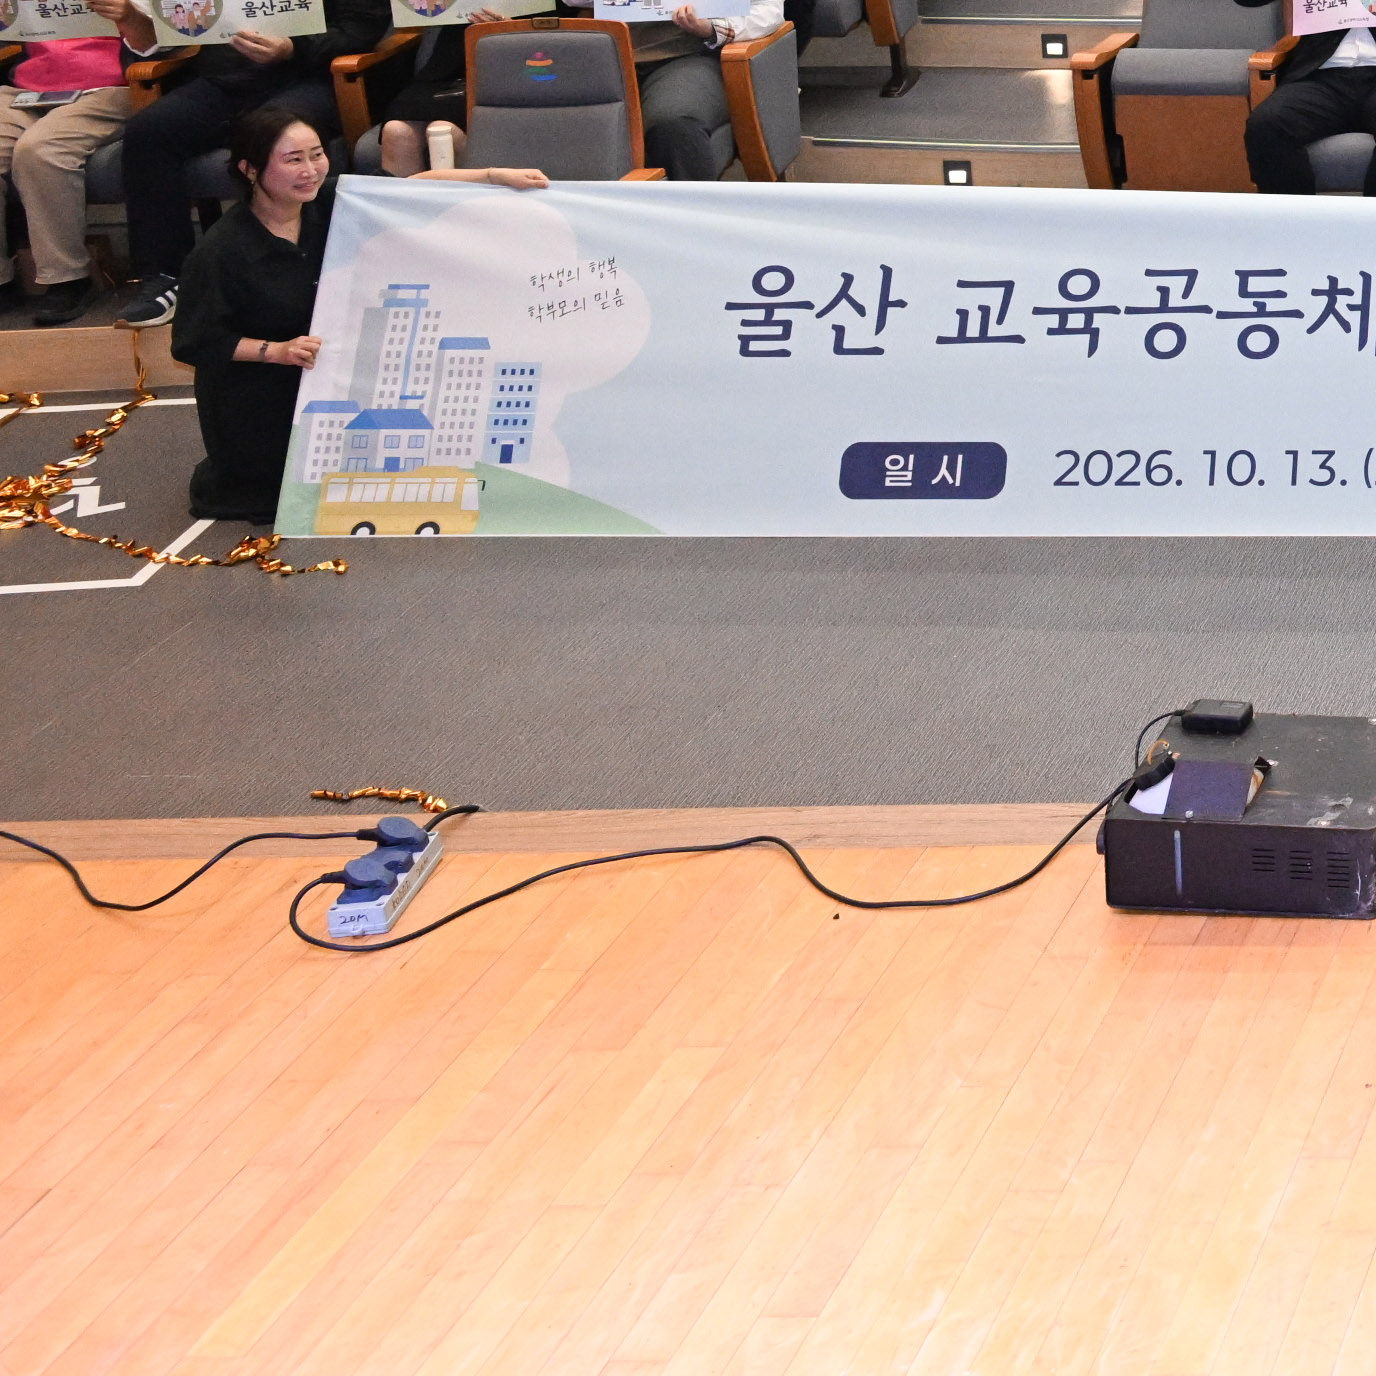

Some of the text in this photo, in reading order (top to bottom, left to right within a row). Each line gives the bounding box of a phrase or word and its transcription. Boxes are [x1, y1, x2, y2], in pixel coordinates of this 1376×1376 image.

[530, 256, 618, 292] 학생의 행복
[528, 288, 626, 323] 학부모의 믿음
[724, 263, 909, 358] 울산
[1053, 449, 1183, 487] 2026.
[1202, 449, 1266, 487] 10.
[1284, 449, 1348, 487] 13.
[340, 914, 369, 924] 20M
